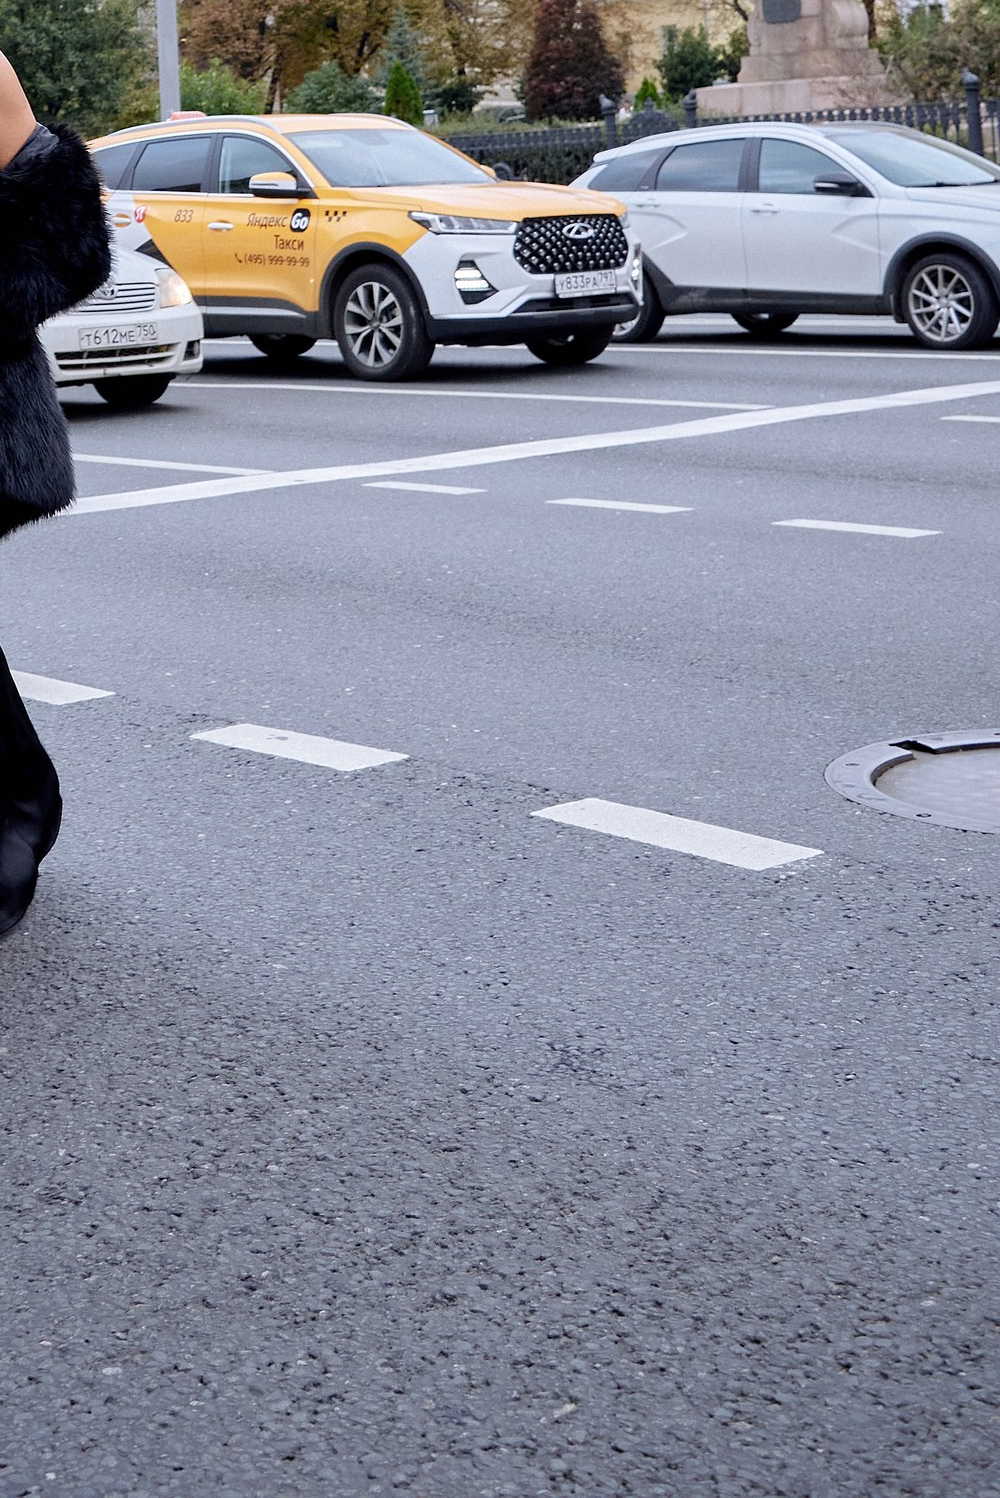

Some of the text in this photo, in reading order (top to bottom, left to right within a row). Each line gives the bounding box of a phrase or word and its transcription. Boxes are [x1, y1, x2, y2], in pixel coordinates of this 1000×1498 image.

[174, 209, 194, 223] 833
[246, 212, 309, 230] Яндекс Go
[273, 234, 304, 251] Такси
[244, 253, 310, 268] (495) 999-99-99
[137, 324, 156, 337] 750
